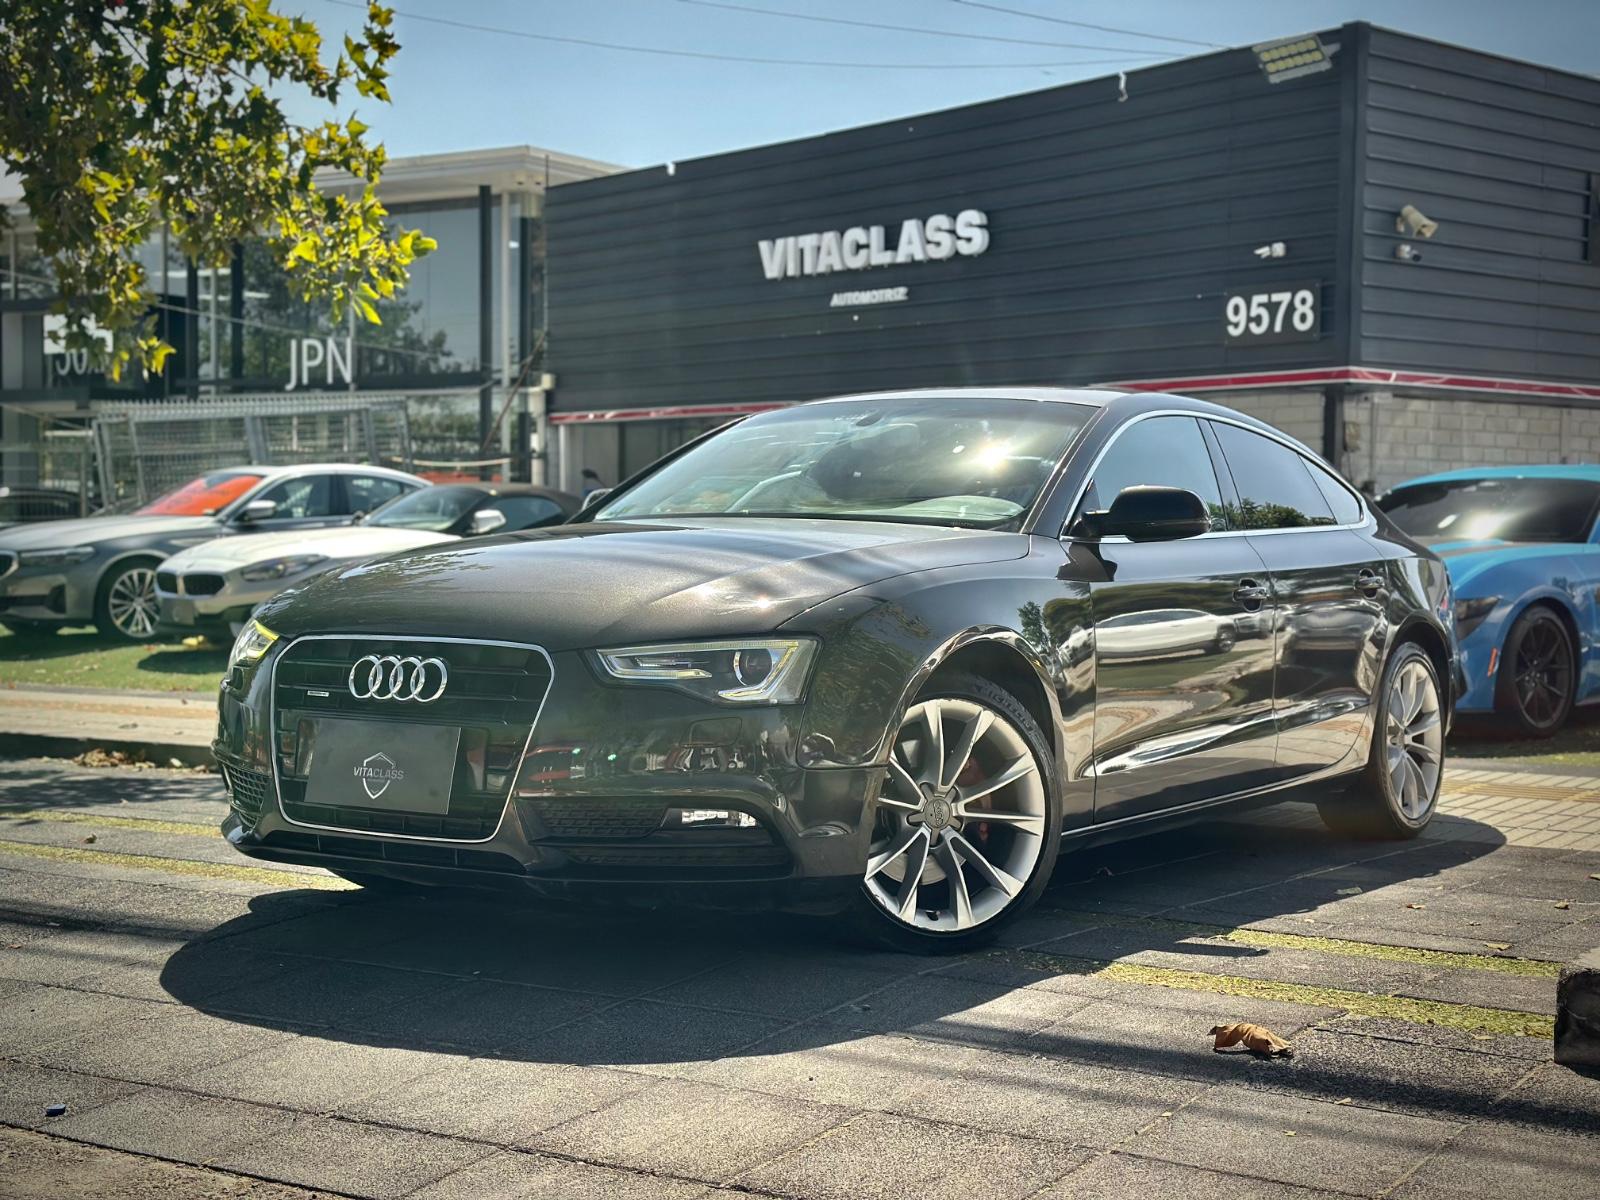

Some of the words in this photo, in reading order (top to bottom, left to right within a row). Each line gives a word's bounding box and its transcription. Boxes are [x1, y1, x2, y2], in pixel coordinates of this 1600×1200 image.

[758, 209, 990, 280] VITACLASS
[1226, 289, 1315, 337] 9578
[285, 338, 352, 391] JPN
[353, 766, 405, 780] VITACLASS
